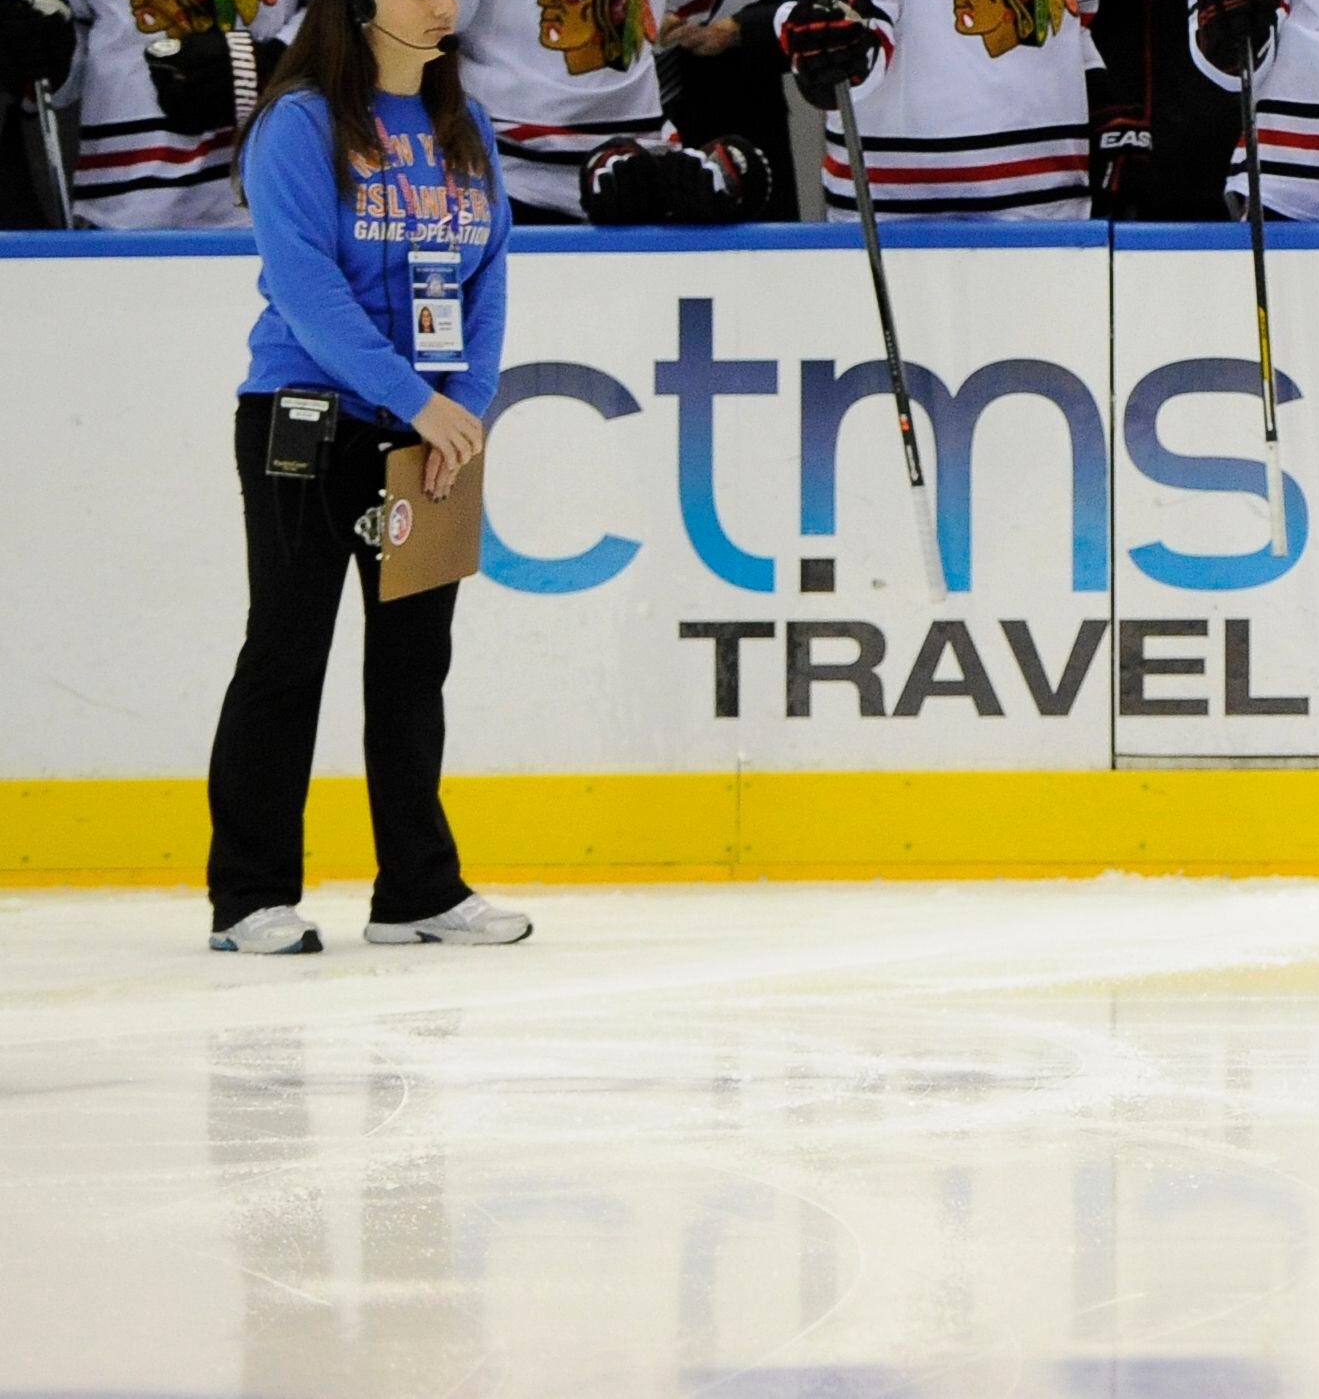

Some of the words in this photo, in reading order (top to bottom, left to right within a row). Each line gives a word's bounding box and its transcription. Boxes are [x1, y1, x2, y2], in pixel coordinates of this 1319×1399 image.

[353, 220, 406, 241] GAME
[479, 297, 1309, 593] ctms
[678, 618, 1310, 718] TRAVEL
